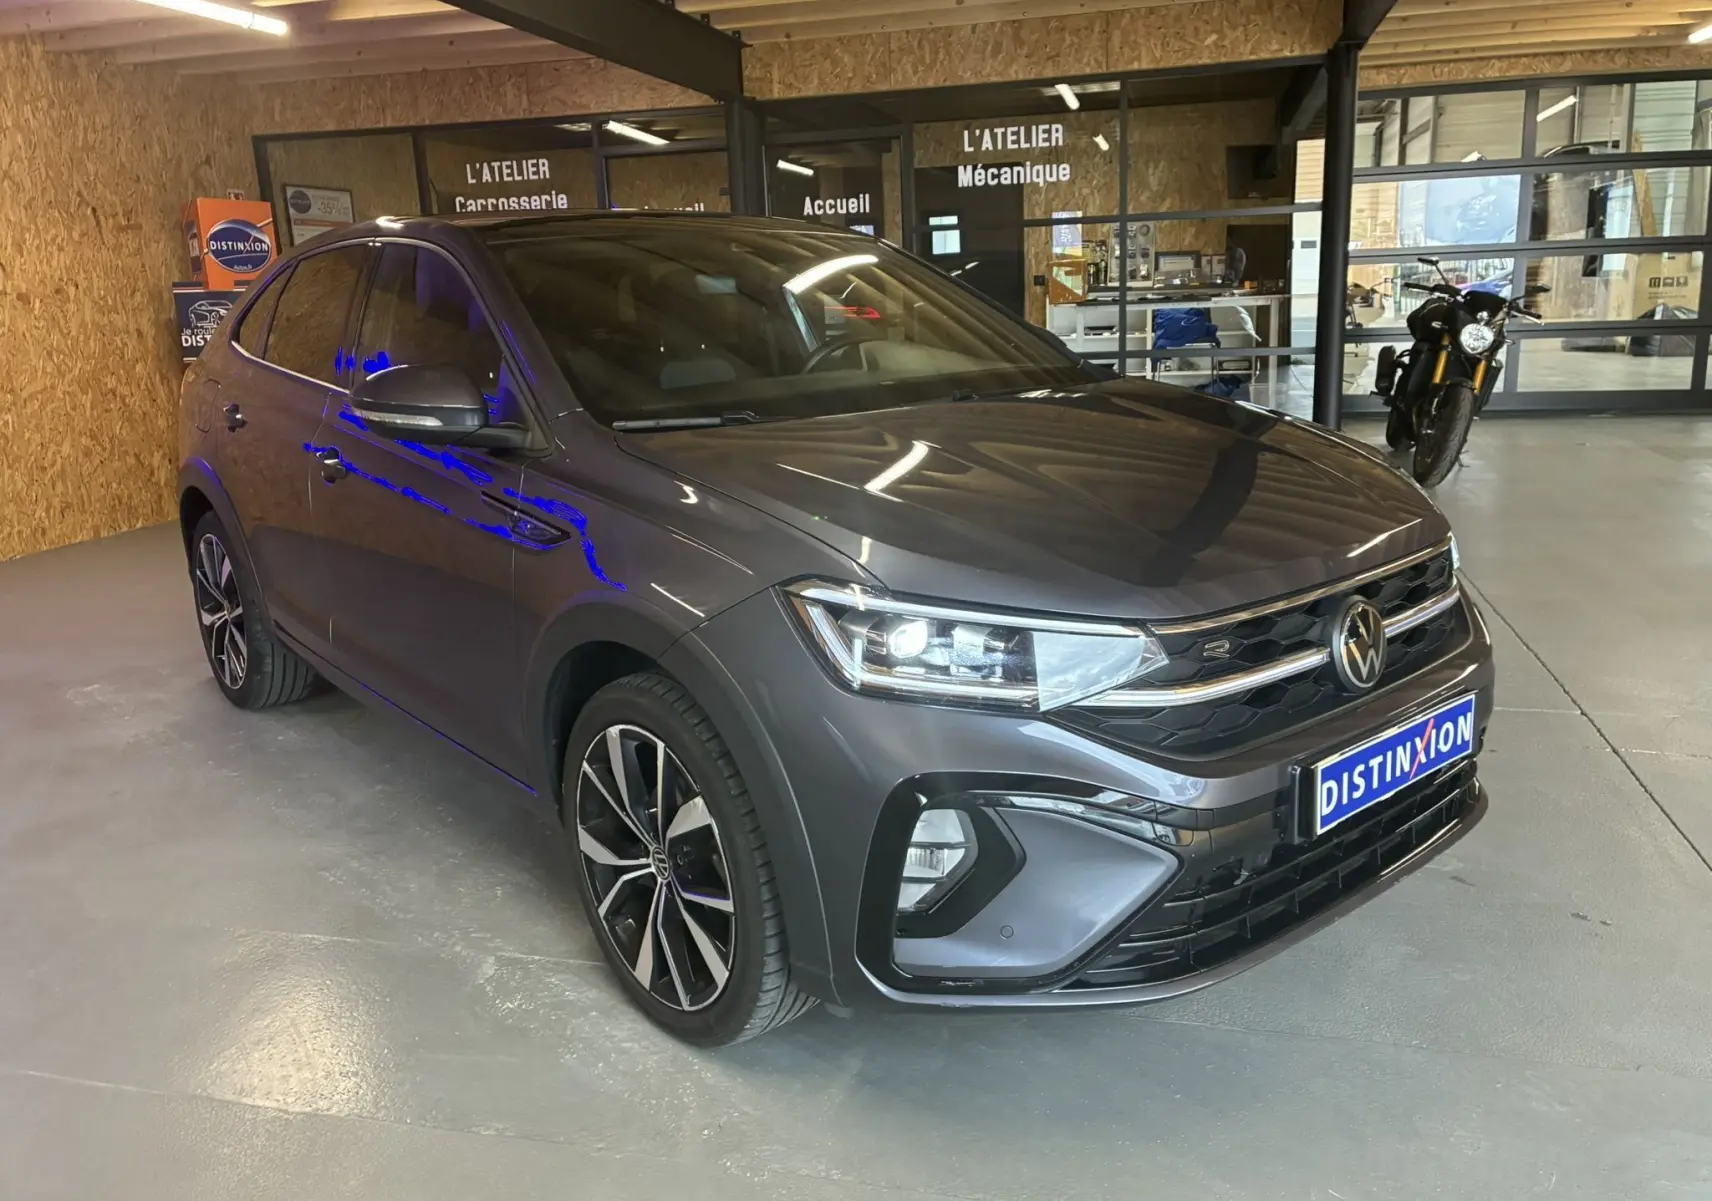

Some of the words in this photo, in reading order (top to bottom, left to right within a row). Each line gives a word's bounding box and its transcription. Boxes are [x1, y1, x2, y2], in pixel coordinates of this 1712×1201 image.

[963, 123, 1064, 152] L'ATELIER
[466, 158, 550, 184] L'ATELIER
[957, 161, 1071, 187] Mécanique
[455, 190, 568, 212] Carrosserie
[803, 193, 870, 216] Accueil
[209, 240, 268, 252] DISTINXION
[181, 328, 192, 336] Je
[1321, 712, 1473, 817] DISTINXION
